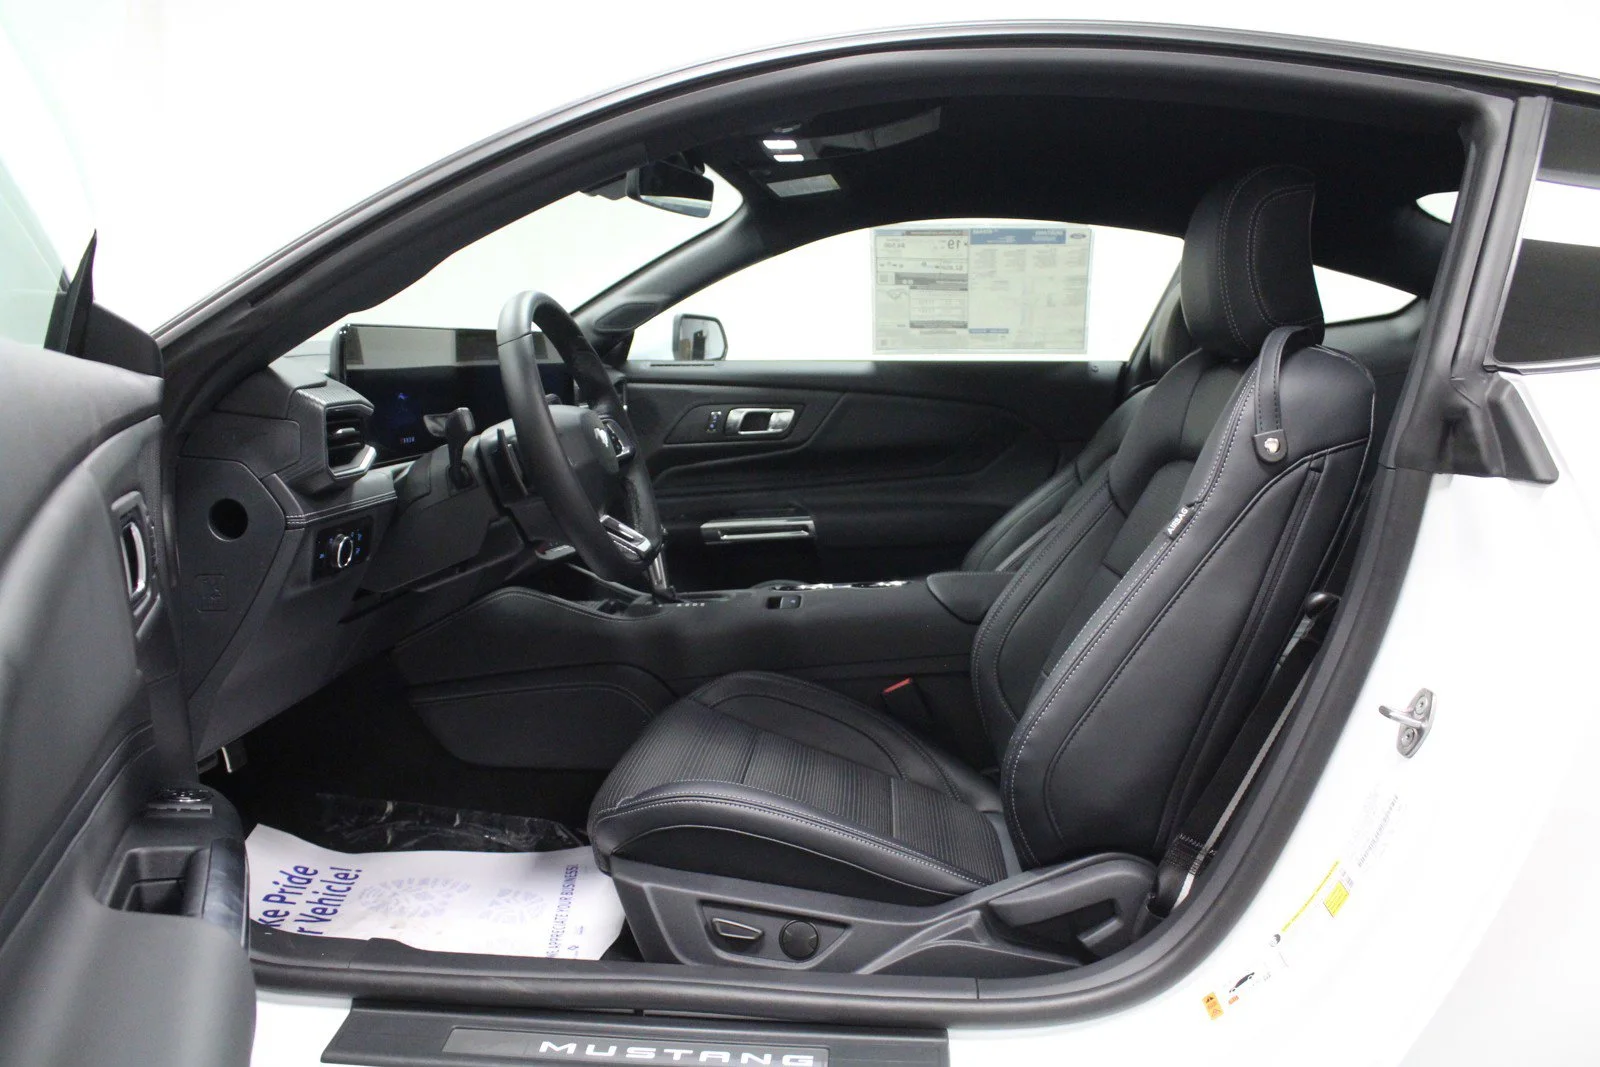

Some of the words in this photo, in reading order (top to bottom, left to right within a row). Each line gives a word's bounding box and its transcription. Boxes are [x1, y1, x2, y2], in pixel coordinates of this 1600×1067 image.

[1167, 507, 1188, 535] AIRBAG
[262, 865, 318, 905] Pride
[294, 866, 363, 923] Vehicle!
[557, 896, 573, 913] YOUR
[548, 914, 568, 949] APPRECIATE
[538, 1041, 815, 1067] MUSTANG
